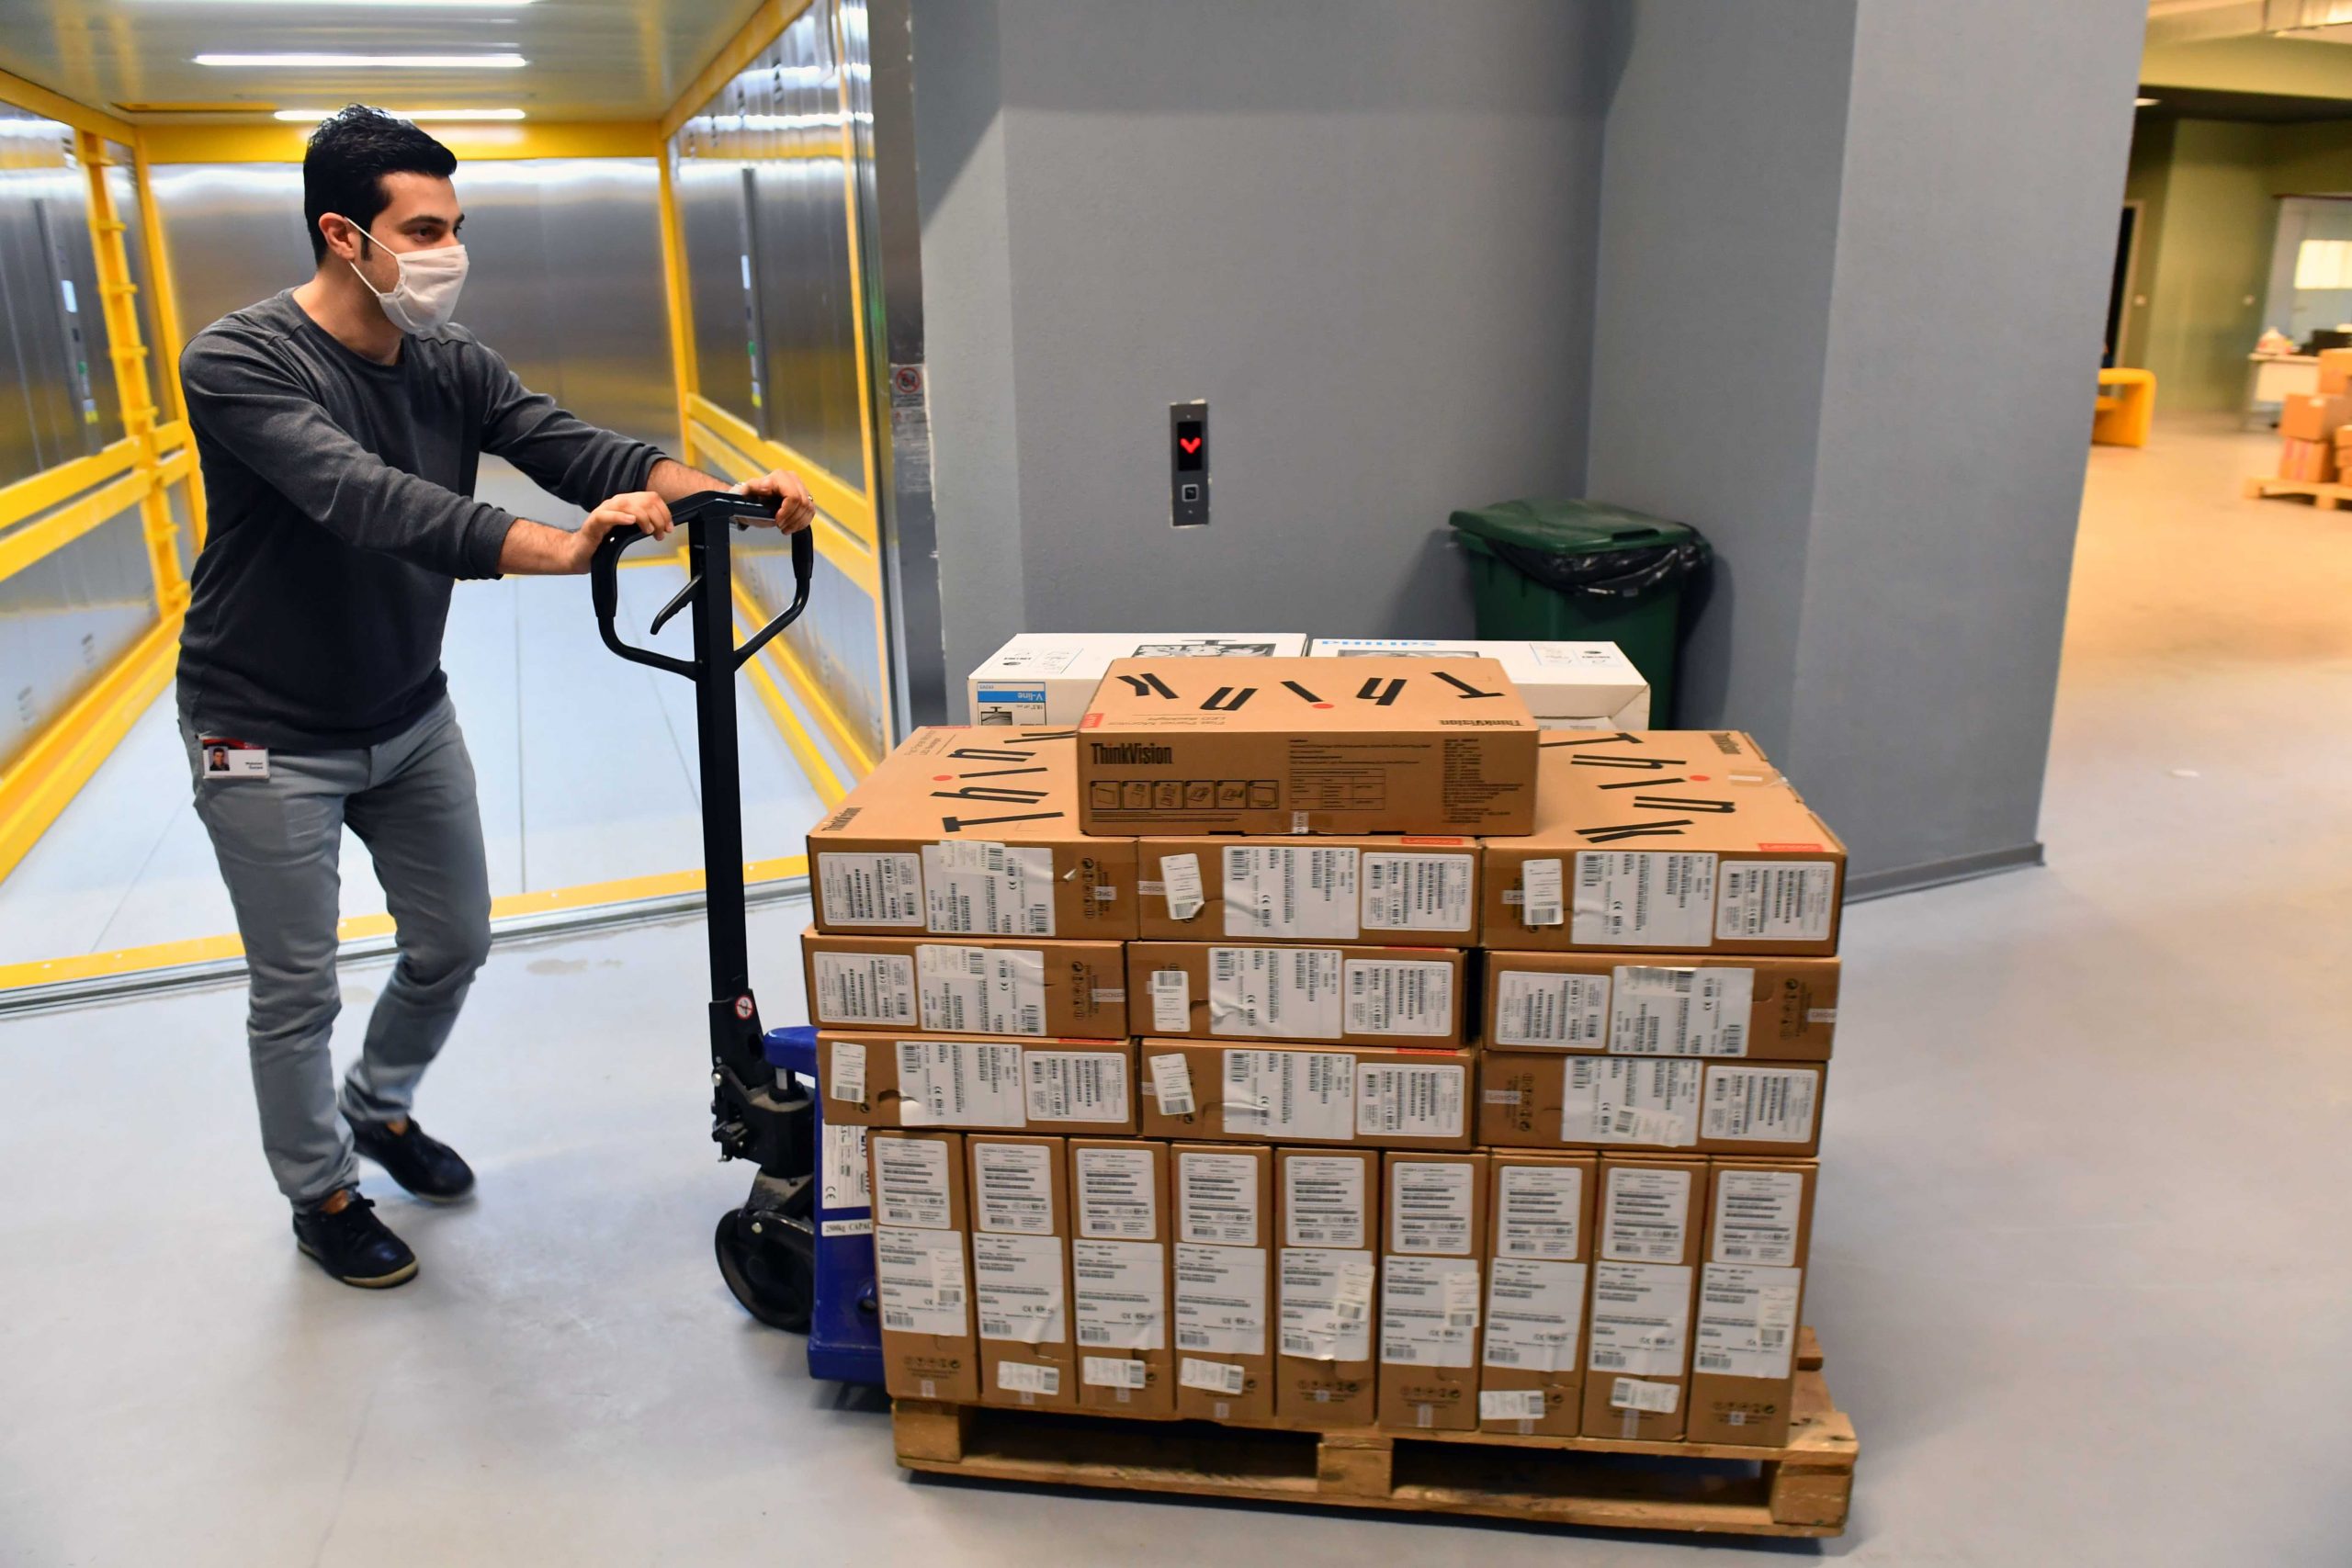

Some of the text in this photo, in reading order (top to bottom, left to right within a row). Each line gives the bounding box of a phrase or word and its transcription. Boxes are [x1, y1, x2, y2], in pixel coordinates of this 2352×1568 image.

[1017, 692, 1044, 701] V-line
[1116, 671, 1506, 711] Think
[1091, 742, 1173, 765] ThinkVision
